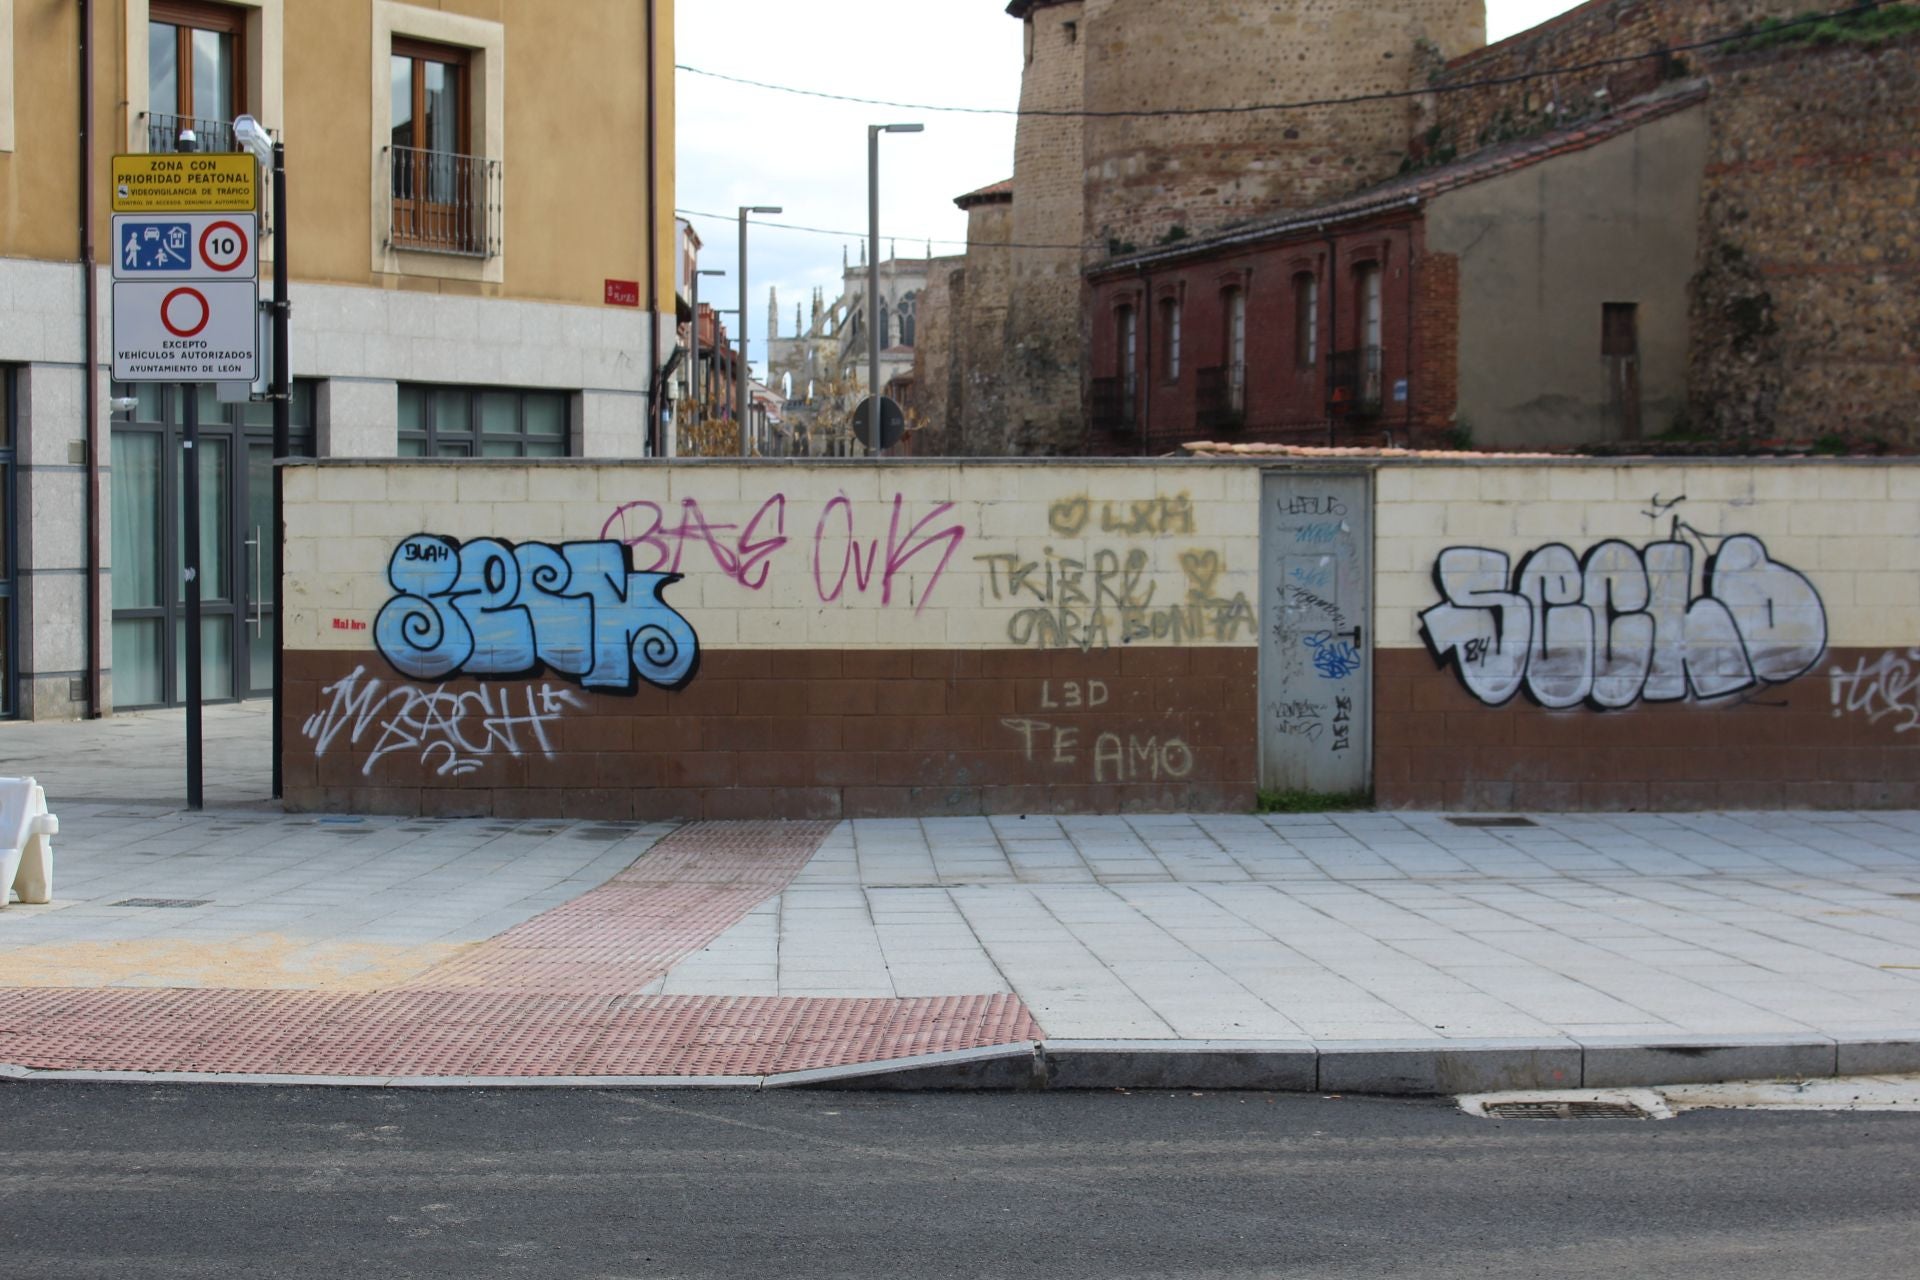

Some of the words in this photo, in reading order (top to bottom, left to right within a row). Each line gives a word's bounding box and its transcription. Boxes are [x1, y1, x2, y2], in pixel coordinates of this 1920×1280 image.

[151, 161, 183, 171] ZONA
[190, 160, 216, 171] CON
[118, 174, 181, 184] PRIORIDAD
[188, 173, 249, 183] PEATONAL
[131, 188, 197, 196] VIDEOVIGILANCIA
[217, 186, 250, 195] TRÁFICO
[211, 238, 235, 255] 10
[162, 340, 208, 349] EXCEPTO
[119, 349, 175, 360] VEHÍCULOS
[181, 351, 252, 360] AUTORIZADOS
[130, 365, 198, 373] AYUNTAMIENTO
[202, 365, 213, 373] DE
[218, 363, 242, 373] LEÓN
[405, 543, 449, 562] BLAH
[1463, 636, 1491, 668] 84
[1001, 717, 1079, 761] TE
[1094, 732, 1194, 783] AMO
